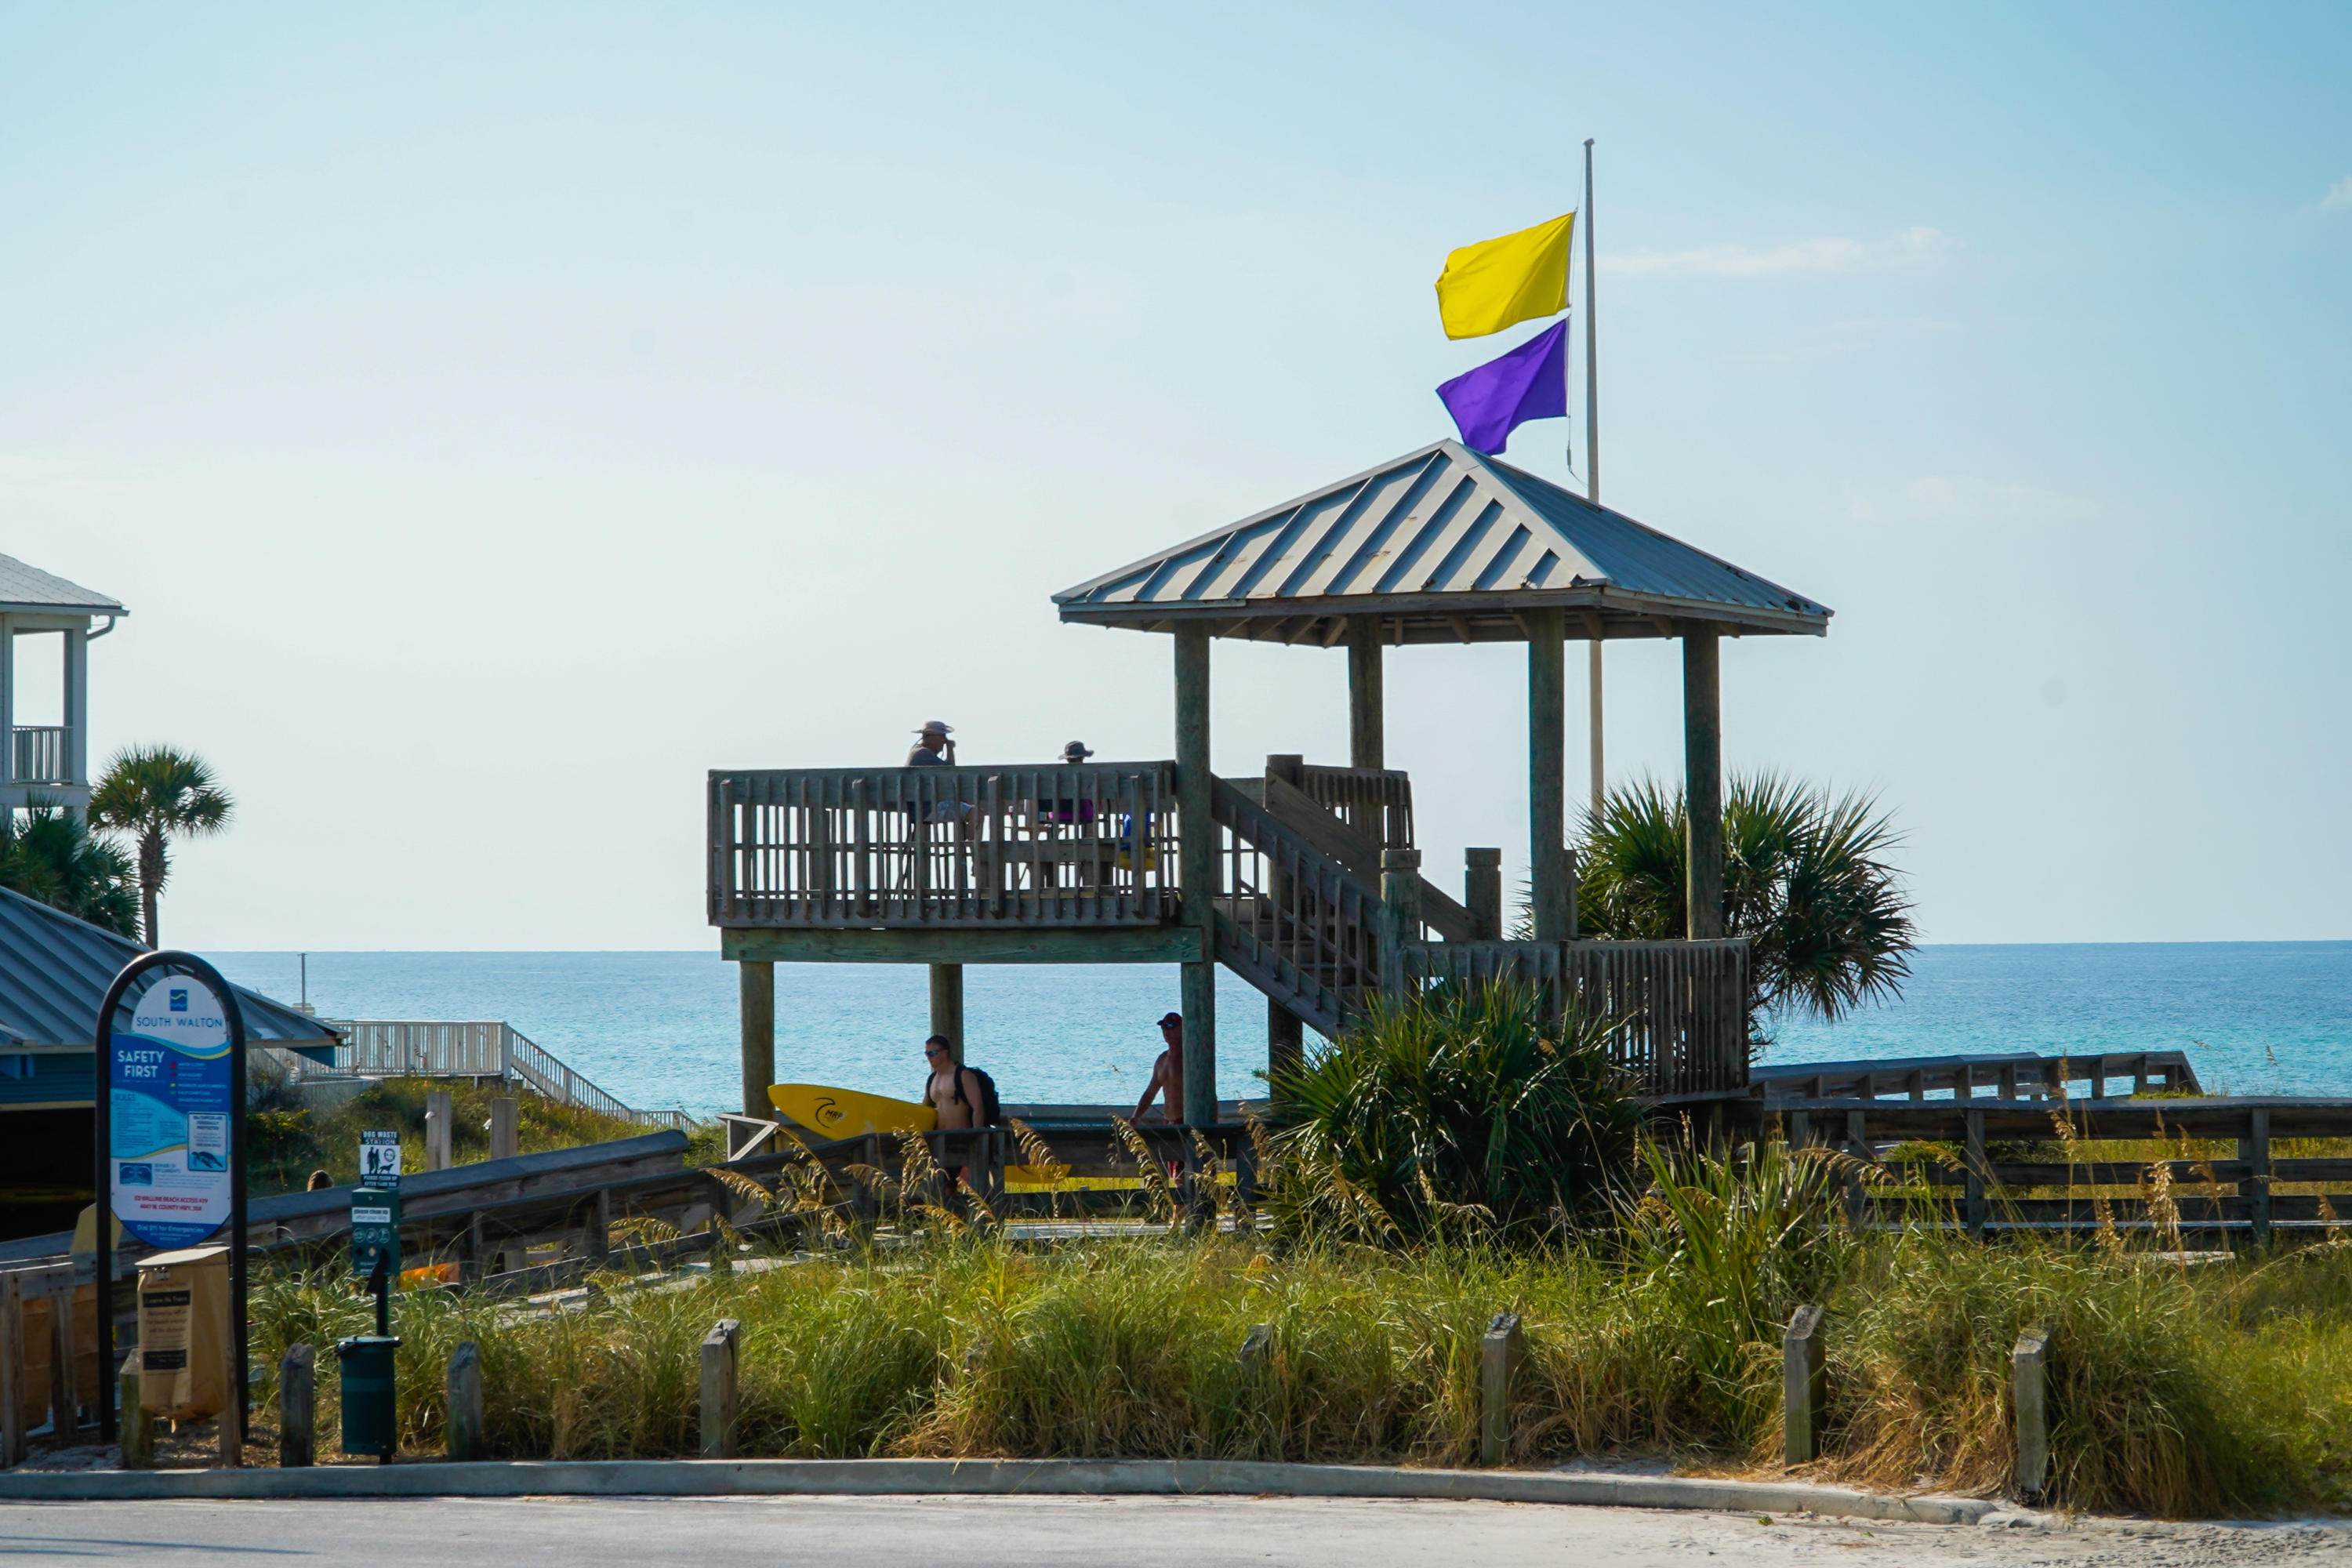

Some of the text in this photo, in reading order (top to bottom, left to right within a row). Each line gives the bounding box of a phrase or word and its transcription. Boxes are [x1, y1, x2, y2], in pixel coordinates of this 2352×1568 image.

[136, 1017, 222, 1028] SOUTH WALTON
[117, 1050, 165, 1063] SAFETY
[125, 1065, 158, 1078] FIRST
